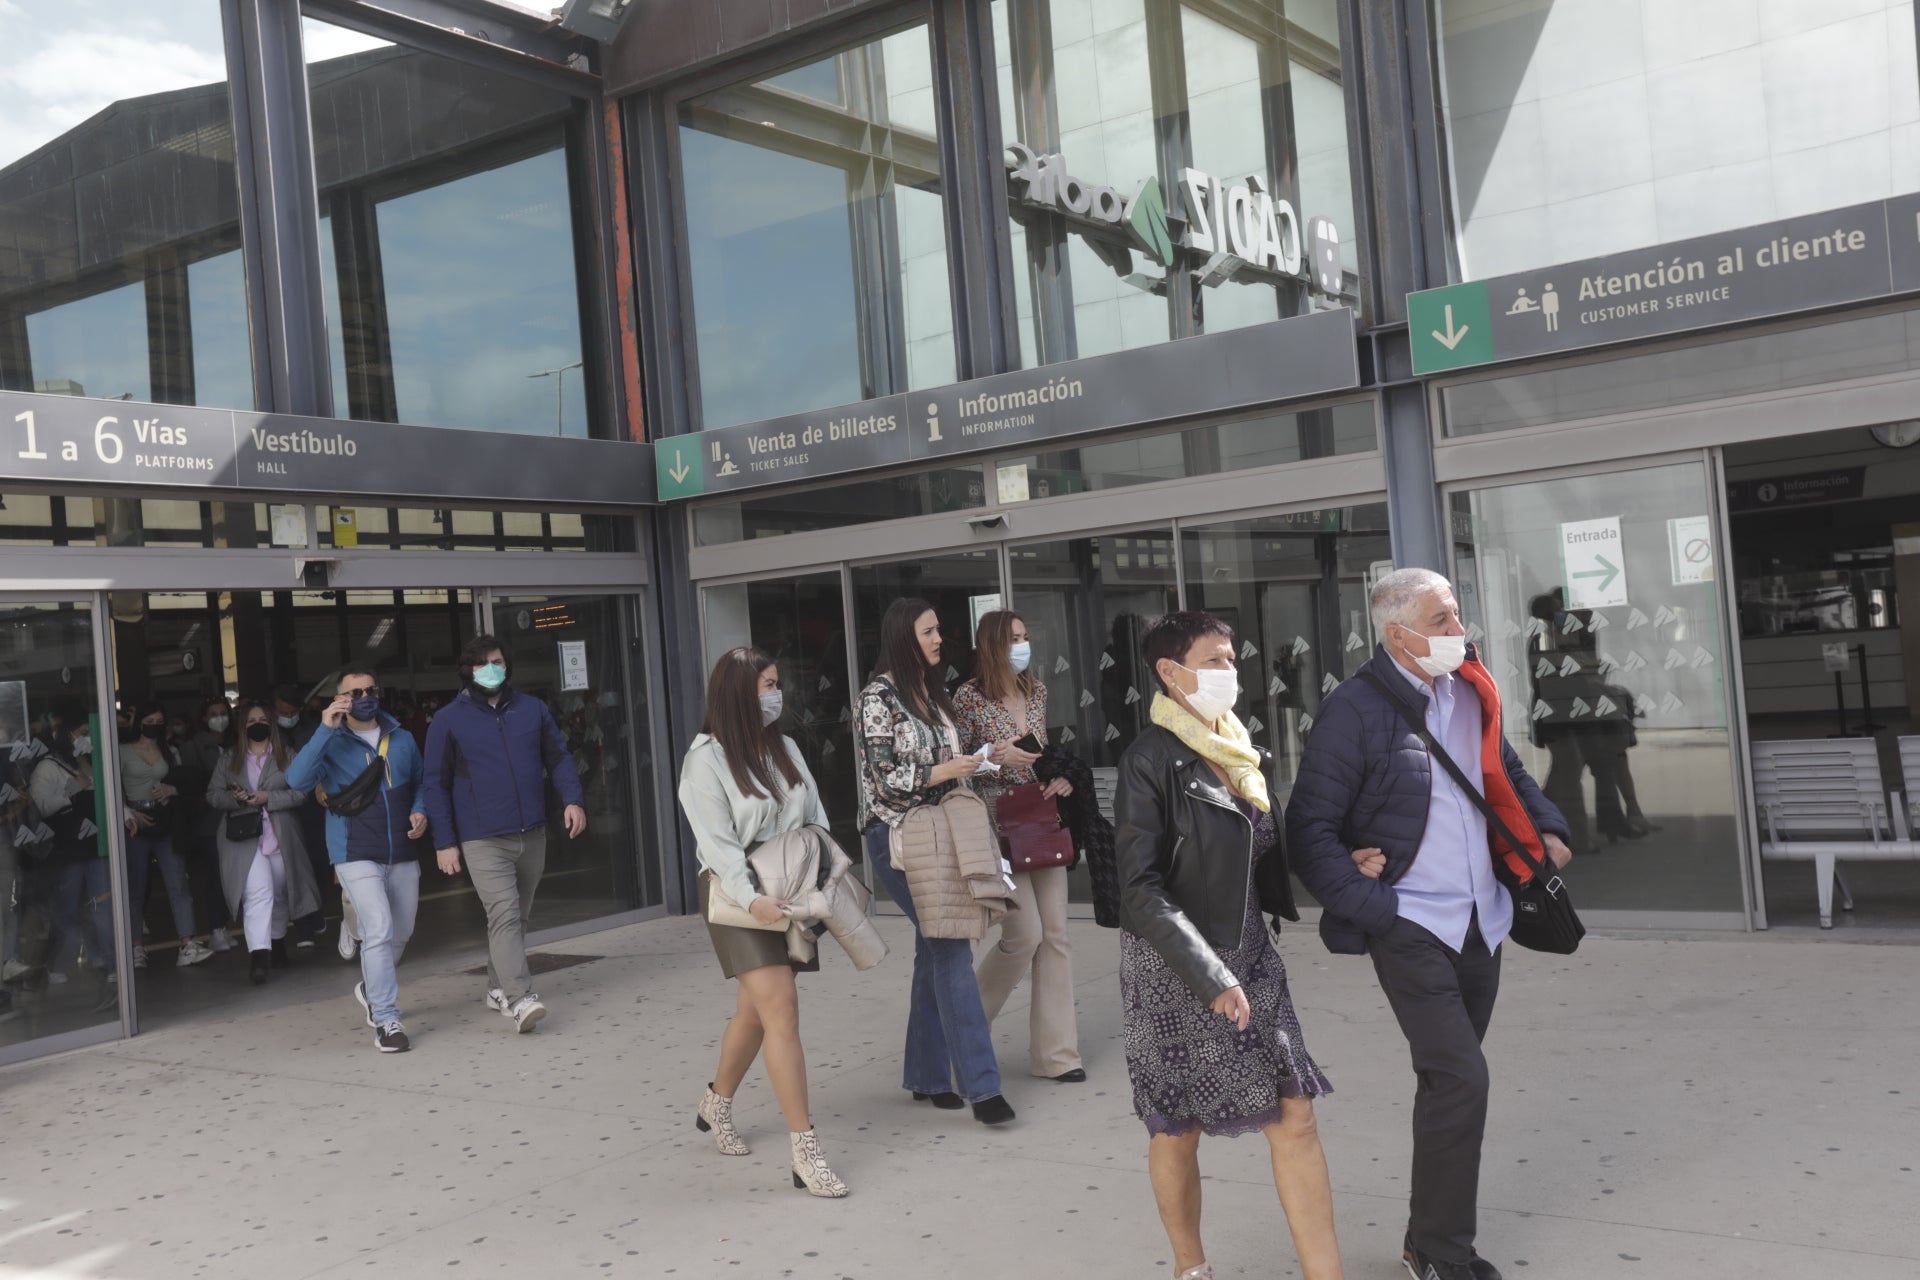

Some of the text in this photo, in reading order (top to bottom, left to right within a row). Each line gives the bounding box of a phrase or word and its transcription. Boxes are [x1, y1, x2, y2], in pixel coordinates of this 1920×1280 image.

[1578, 227, 1866, 301] Atención al cliente
[1580, 286, 1730, 325] CUSTOMER SERVICE
[958, 376, 1083, 418] Información
[15, 410, 123, 464] 1 a 6
[132, 418, 188, 446] Vías
[747, 414, 897, 455] Venta de billetes
[961, 414, 1035, 437] INFORMATION
[251, 428, 357, 457] Vestíbulo
[135, 454, 214, 471] PLATFORMS
[257, 461, 287, 474] HALL
[750, 453, 809, 472] TICKET SALES
[1783, 475, 1850, 491] Información
[1566, 527, 1617, 544] Entrada
